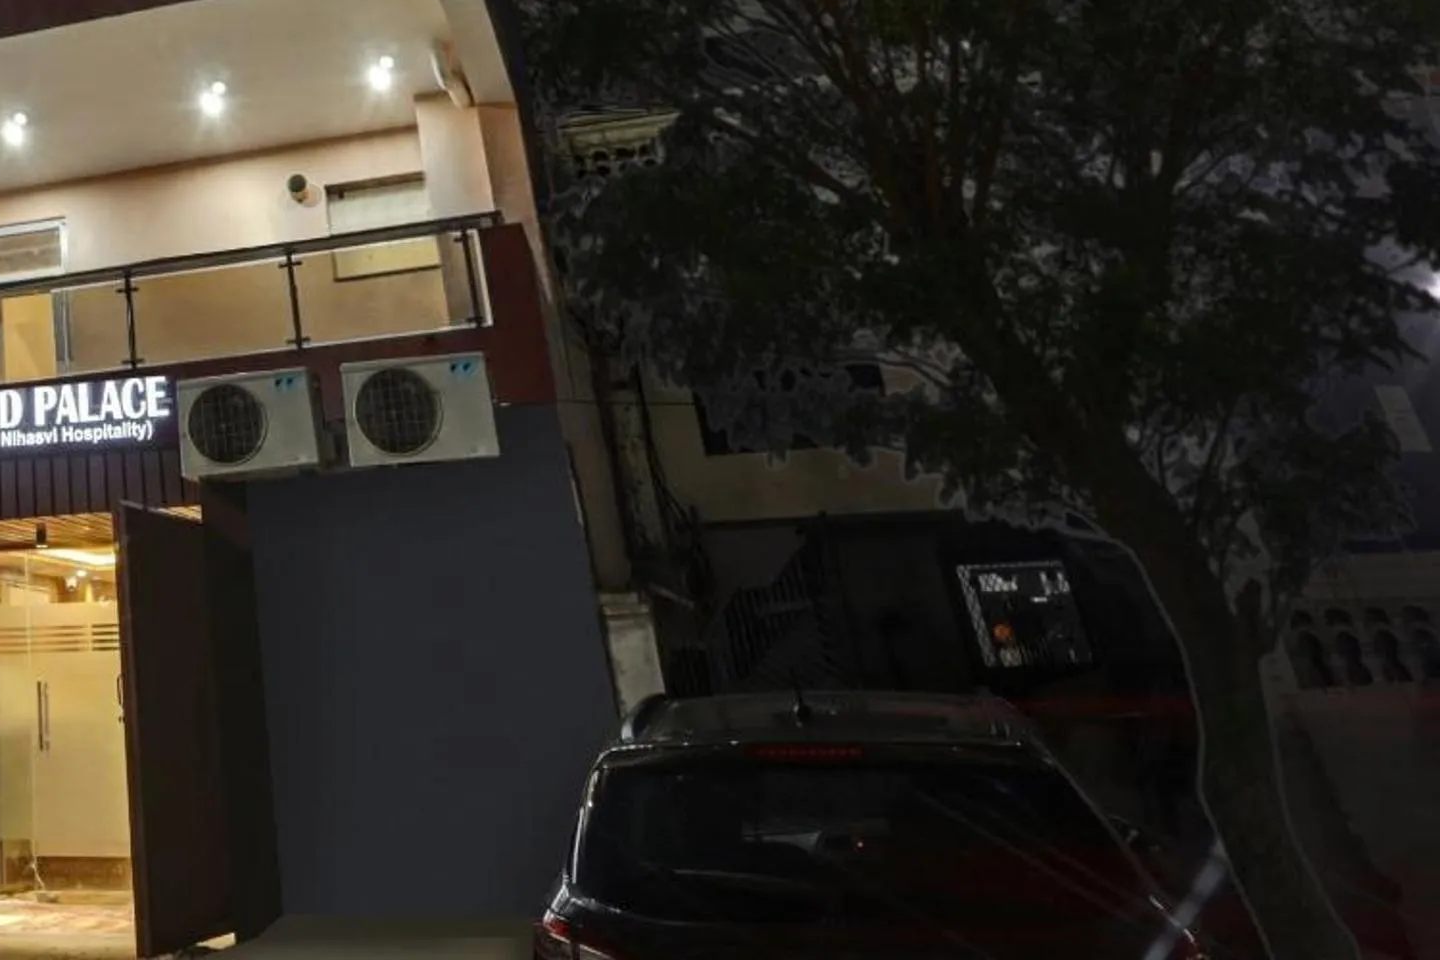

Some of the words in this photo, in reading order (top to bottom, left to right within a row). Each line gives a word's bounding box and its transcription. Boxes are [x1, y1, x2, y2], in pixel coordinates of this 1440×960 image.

[34, 375, 170, 427] PALACE
[0, 428, 58, 448] Nihasvi
[62, 420, 153, 444] Hospitality)
